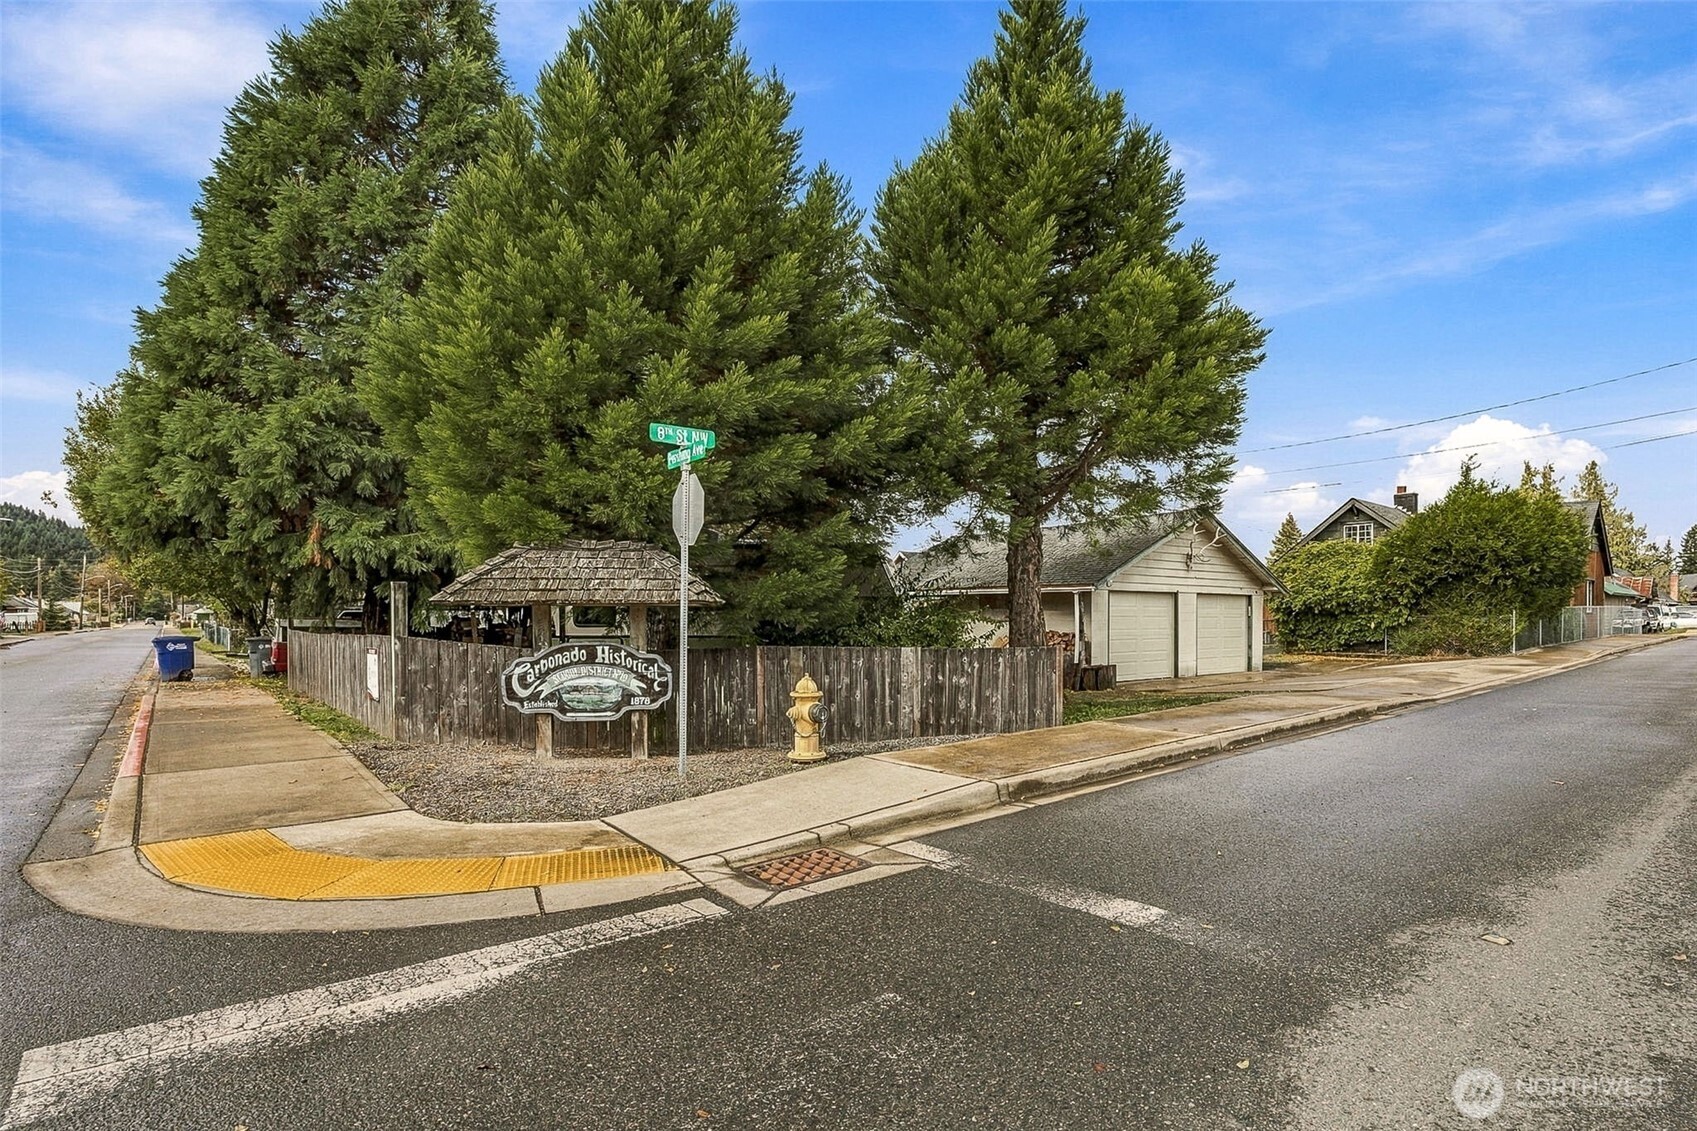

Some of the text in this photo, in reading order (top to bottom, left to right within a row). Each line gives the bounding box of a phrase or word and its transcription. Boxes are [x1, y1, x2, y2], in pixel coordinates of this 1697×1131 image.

[676, 429, 688, 444] St
[692, 431, 709, 447] NW
[692, 443, 704, 457] Ave
[595, 646, 668, 691] Historical
[630, 696, 651, 705] 1878
